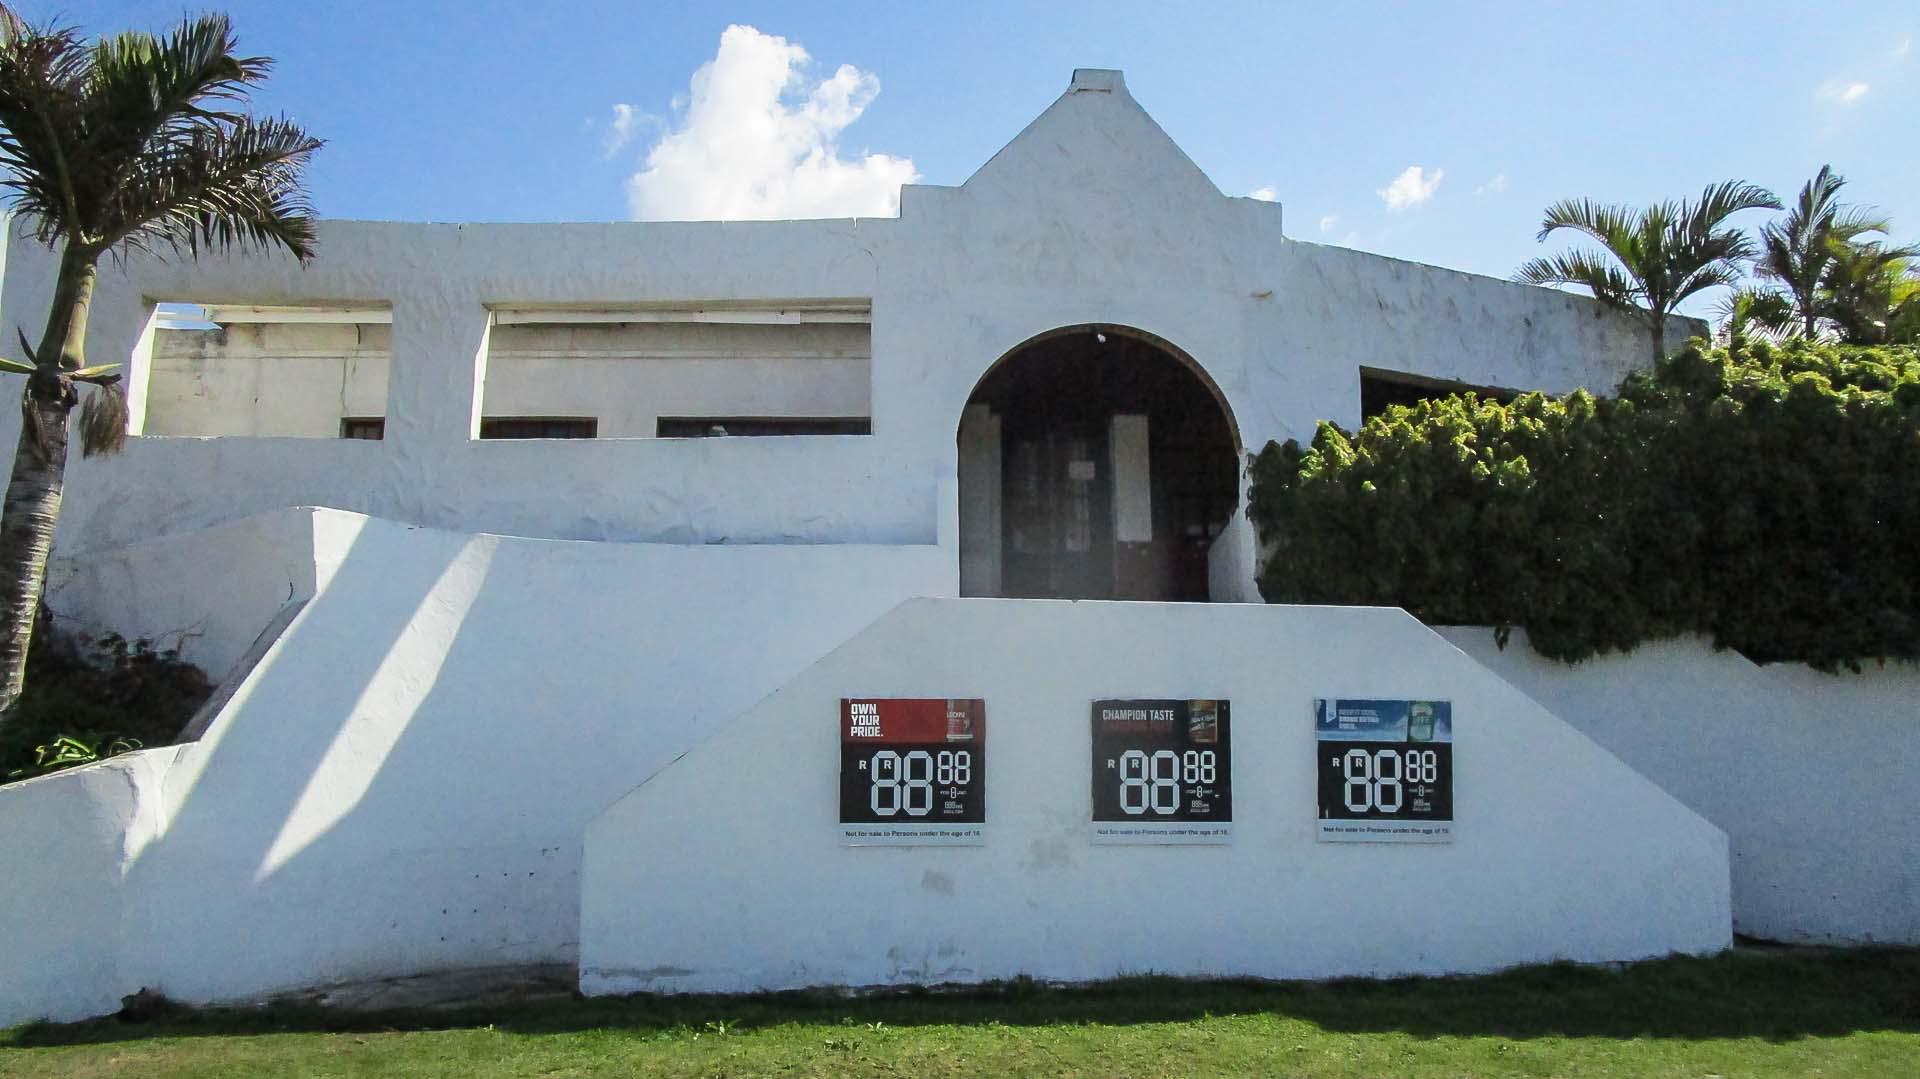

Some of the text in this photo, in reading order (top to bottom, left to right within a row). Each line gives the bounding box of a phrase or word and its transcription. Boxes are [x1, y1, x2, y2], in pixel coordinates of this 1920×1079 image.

[851, 704, 877, 715] OWN
[1102, 709, 1175, 721] CHAMPION TASTE
[851, 715, 880, 726] YOUR
[850, 726, 884, 737] PRIDE.
[858, 760, 867, 770] R
[937, 750, 971, 785] 88
[1107, 760, 1116, 769] R
[1183, 750, 1216, 784] 88
[1332, 758, 1340, 767] R
[1405, 750, 1437, 783] 88
[951, 830, 962, 838] age
